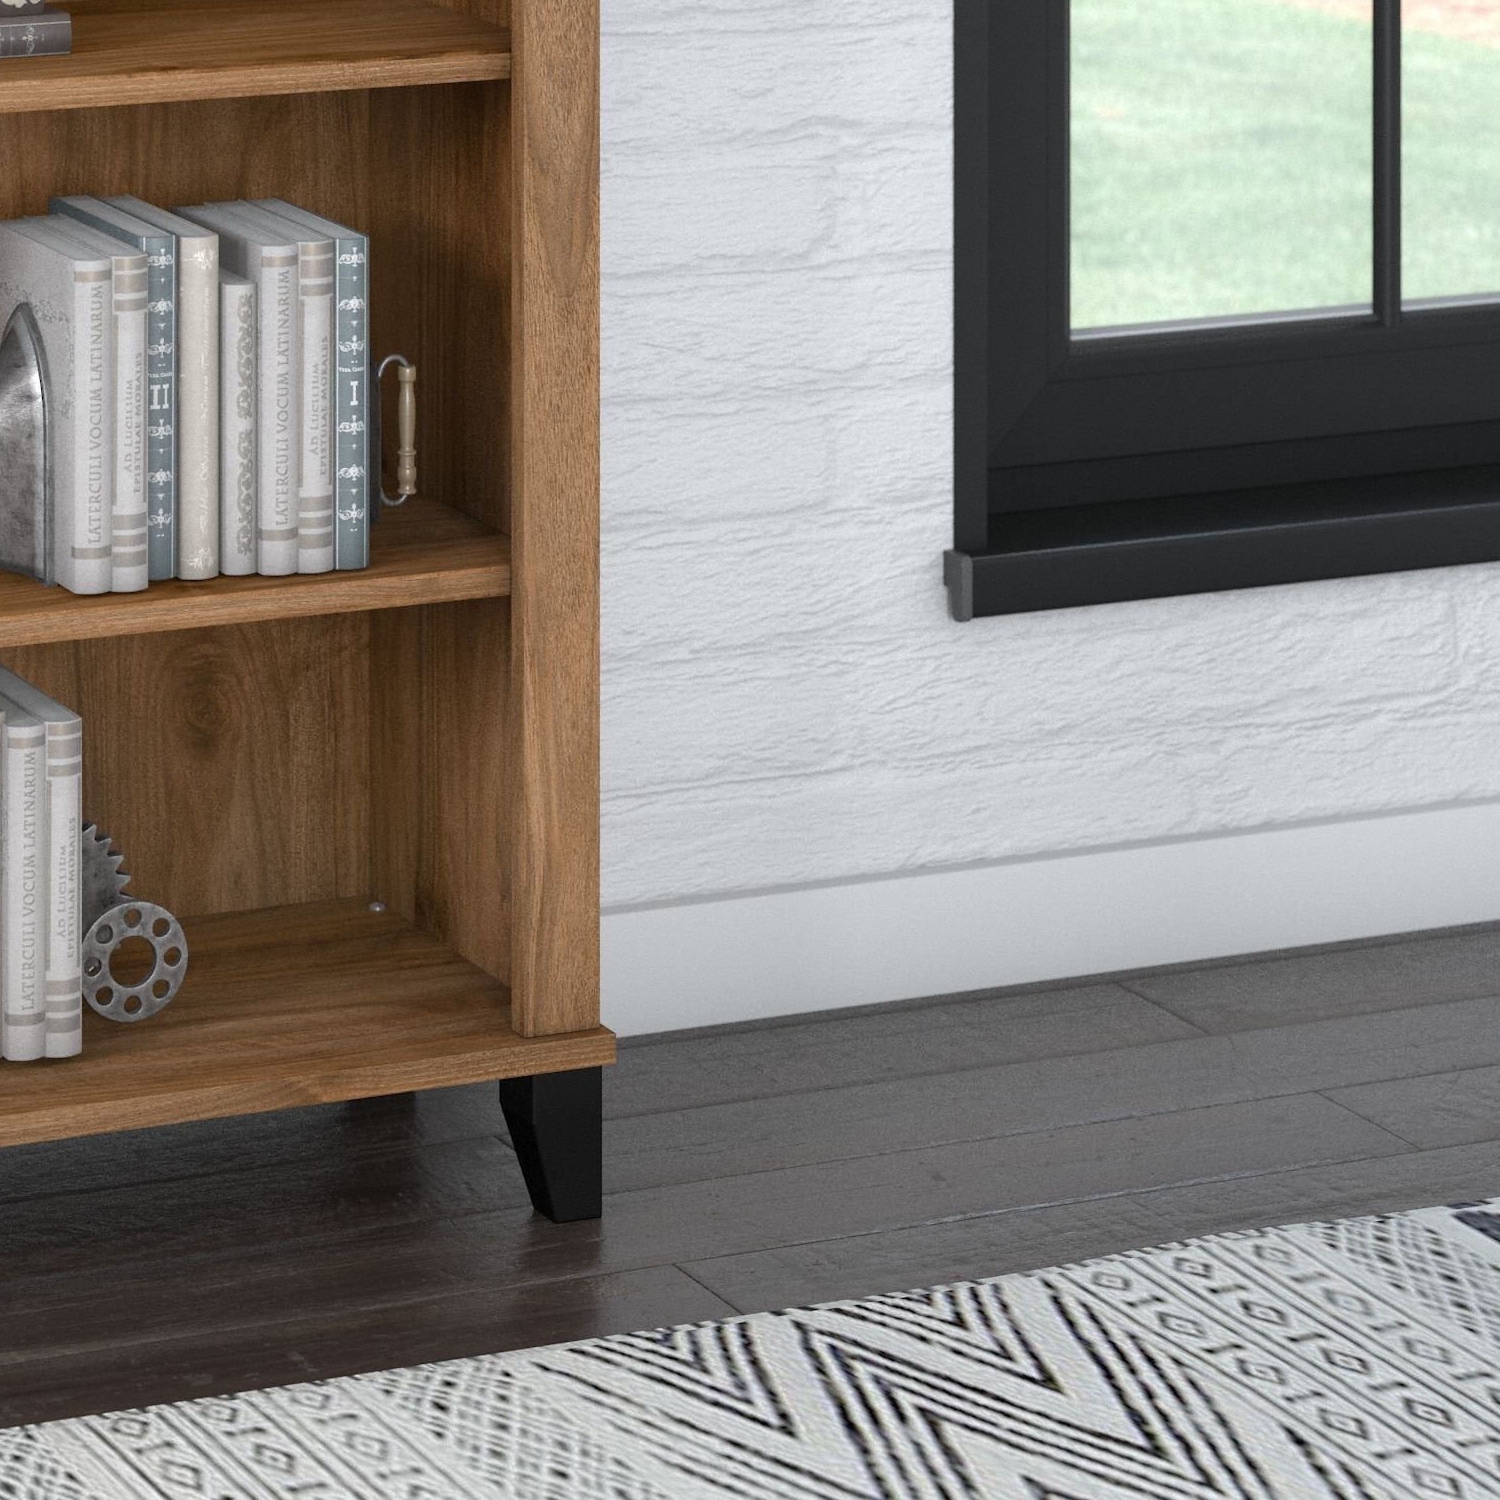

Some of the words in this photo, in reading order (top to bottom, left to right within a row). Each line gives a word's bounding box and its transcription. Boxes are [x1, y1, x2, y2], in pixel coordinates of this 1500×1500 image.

[90, 284, 103, 381] LATINARUM
[277, 269, 290, 366] LATINARUM
[89, 388, 102, 450] VOCUM
[150, 384, 170, 409] II
[276, 371, 289, 432] VOCUM
[350, 381, 358, 405] I
[88, 457, 102, 544] LATERCULI
[275, 439, 288, 526] LATERCULI
[23, 750, 36, 849] LATINARUM
[22, 854, 36, 917] VOCUM
[21, 923, 36, 1011] LATERCULI
